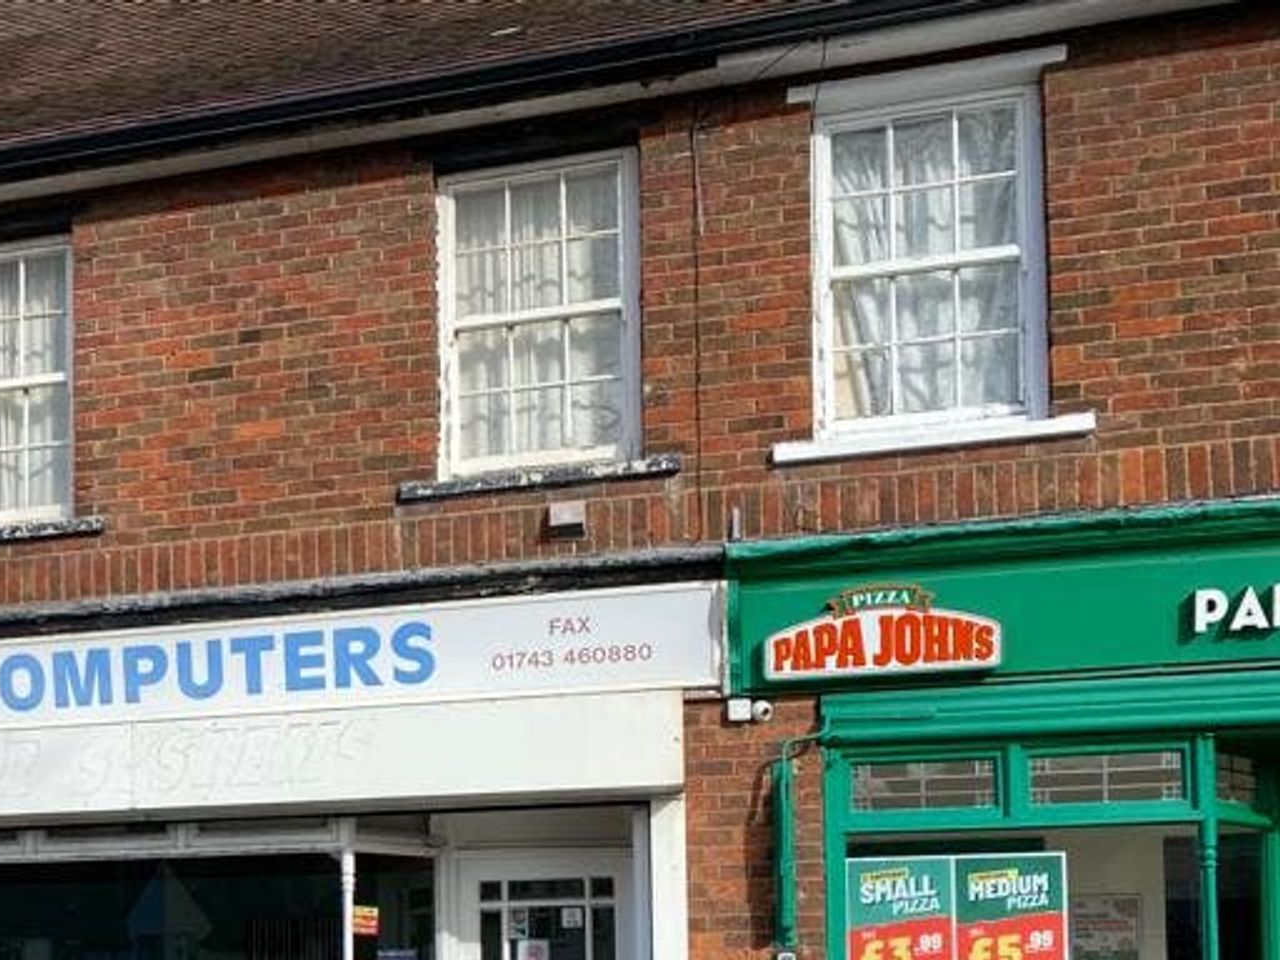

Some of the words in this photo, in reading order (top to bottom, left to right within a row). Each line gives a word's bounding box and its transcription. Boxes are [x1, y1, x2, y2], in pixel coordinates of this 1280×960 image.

[852, 590, 911, 607] PIZZA
[548, 617, 592, 635] FAX
[773, 617, 866, 672] PAPA
[873, 613, 995, 667] JOHNS
[492, 649, 554, 671] 01743
[563, 644, 652, 664] 460880
[861, 875, 937, 904] SMALL
[968, 873, 1049, 901] MEDIUM
[892, 898, 941, 915] PIZZA
[1007, 893, 1049, 911] PIZZA
